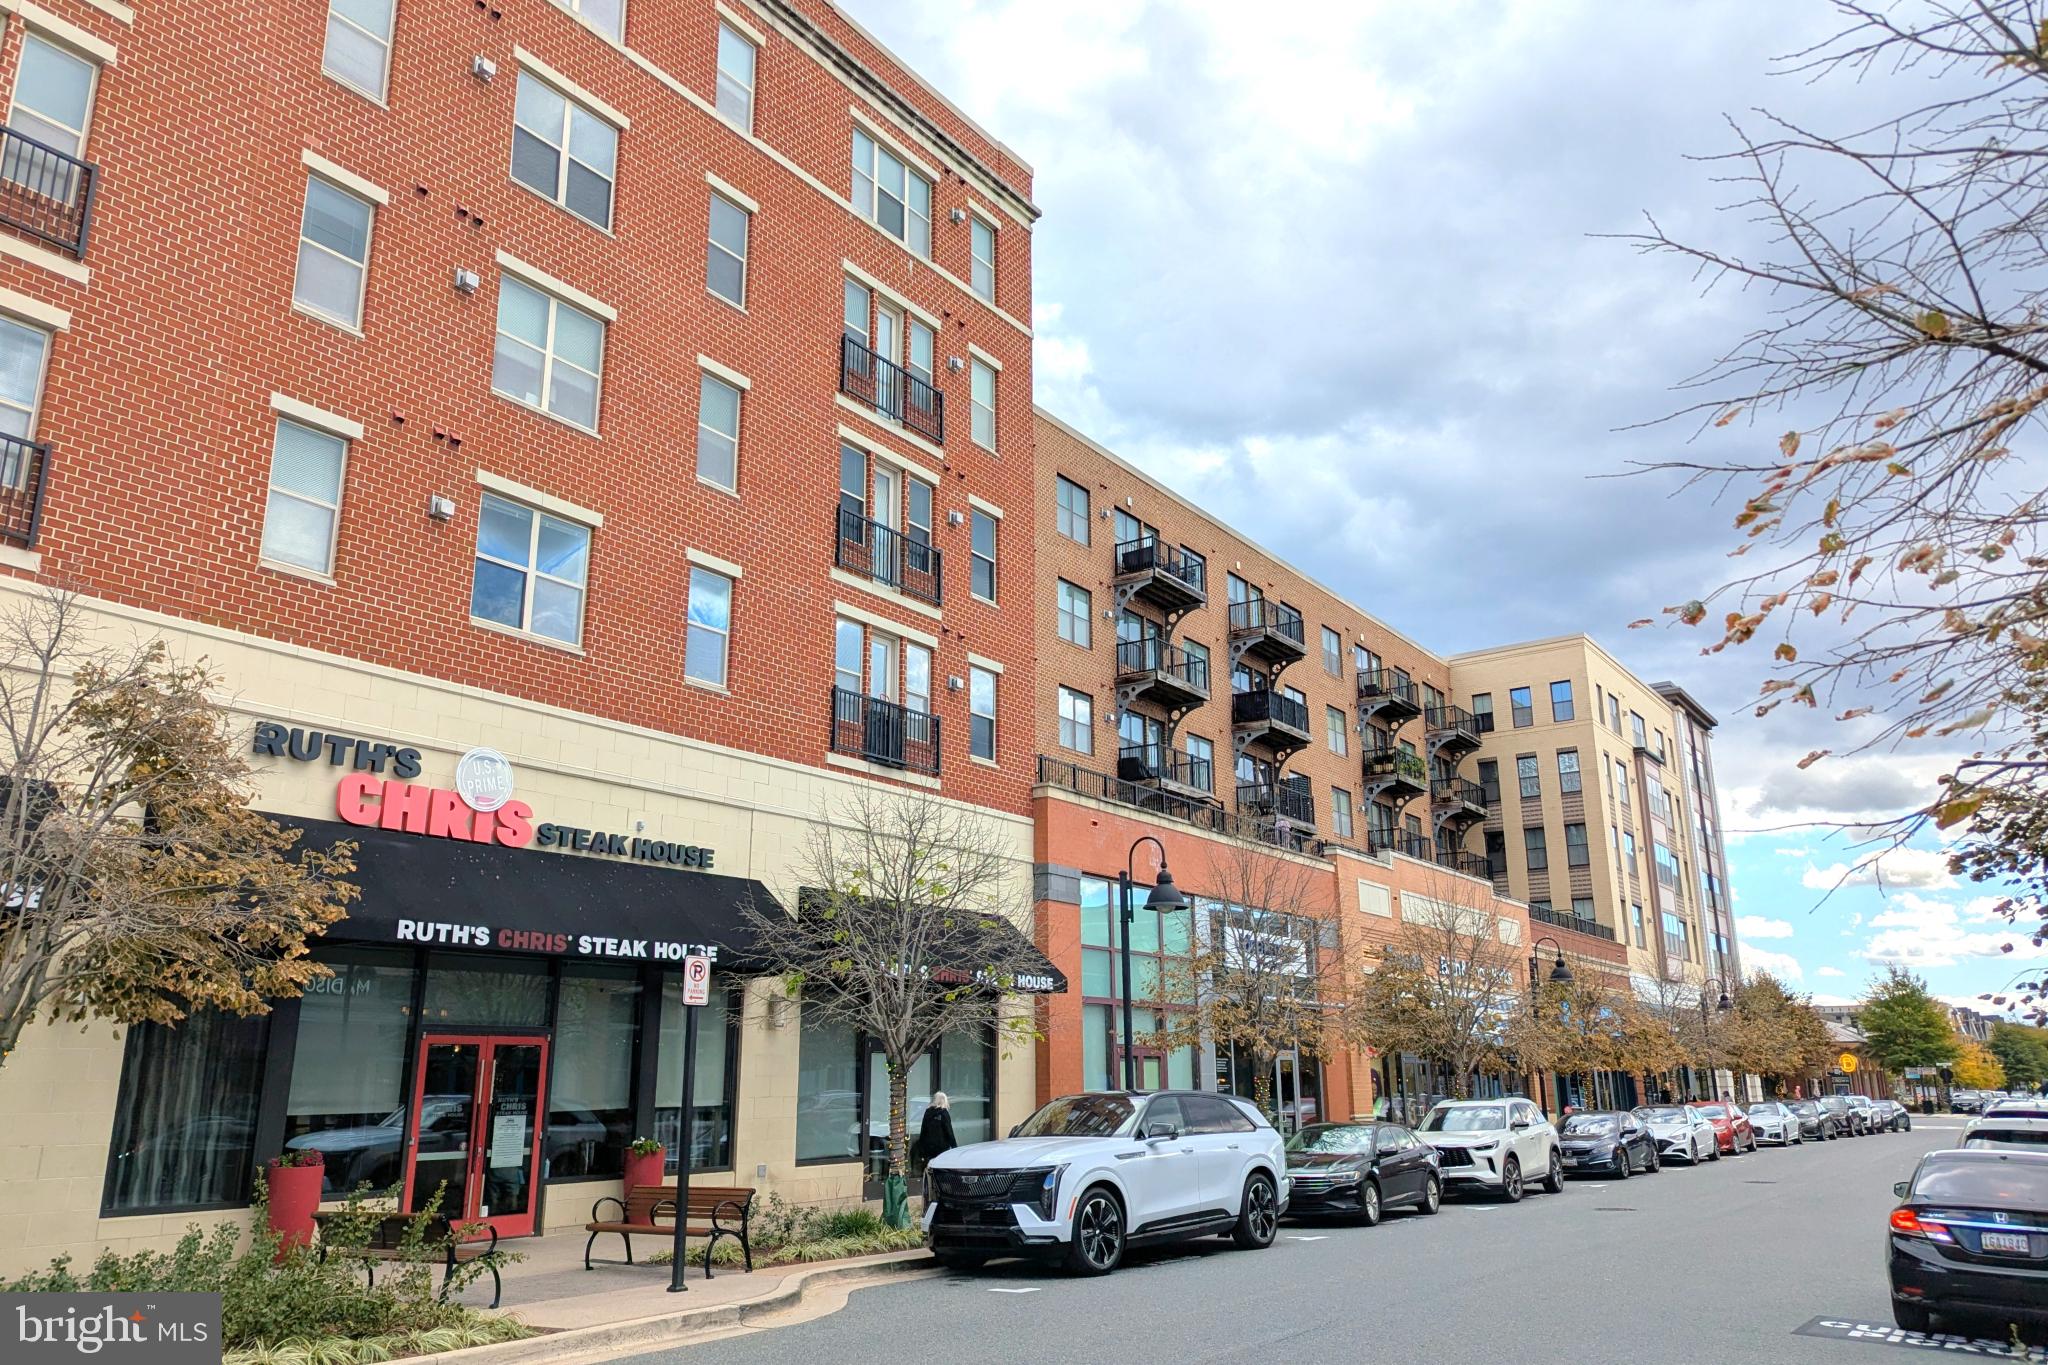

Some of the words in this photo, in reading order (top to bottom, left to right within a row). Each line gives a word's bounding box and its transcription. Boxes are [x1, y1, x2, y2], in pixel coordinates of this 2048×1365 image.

[253, 721, 422, 778] RUTH'S
[473, 760, 495, 775] U.S.
[467, 776, 504, 794] PRIME
[336, 772, 533, 848] CHRIS
[538, 822, 629, 856] STEAK
[632, 837, 715, 868] HOUSE
[397, 919, 490, 946] RUTH'S
[578, 935, 647, 957] STEAK
[1017, 974, 1054, 990] HOUSE
[500, 1102, 527, 1110] CHRIS
